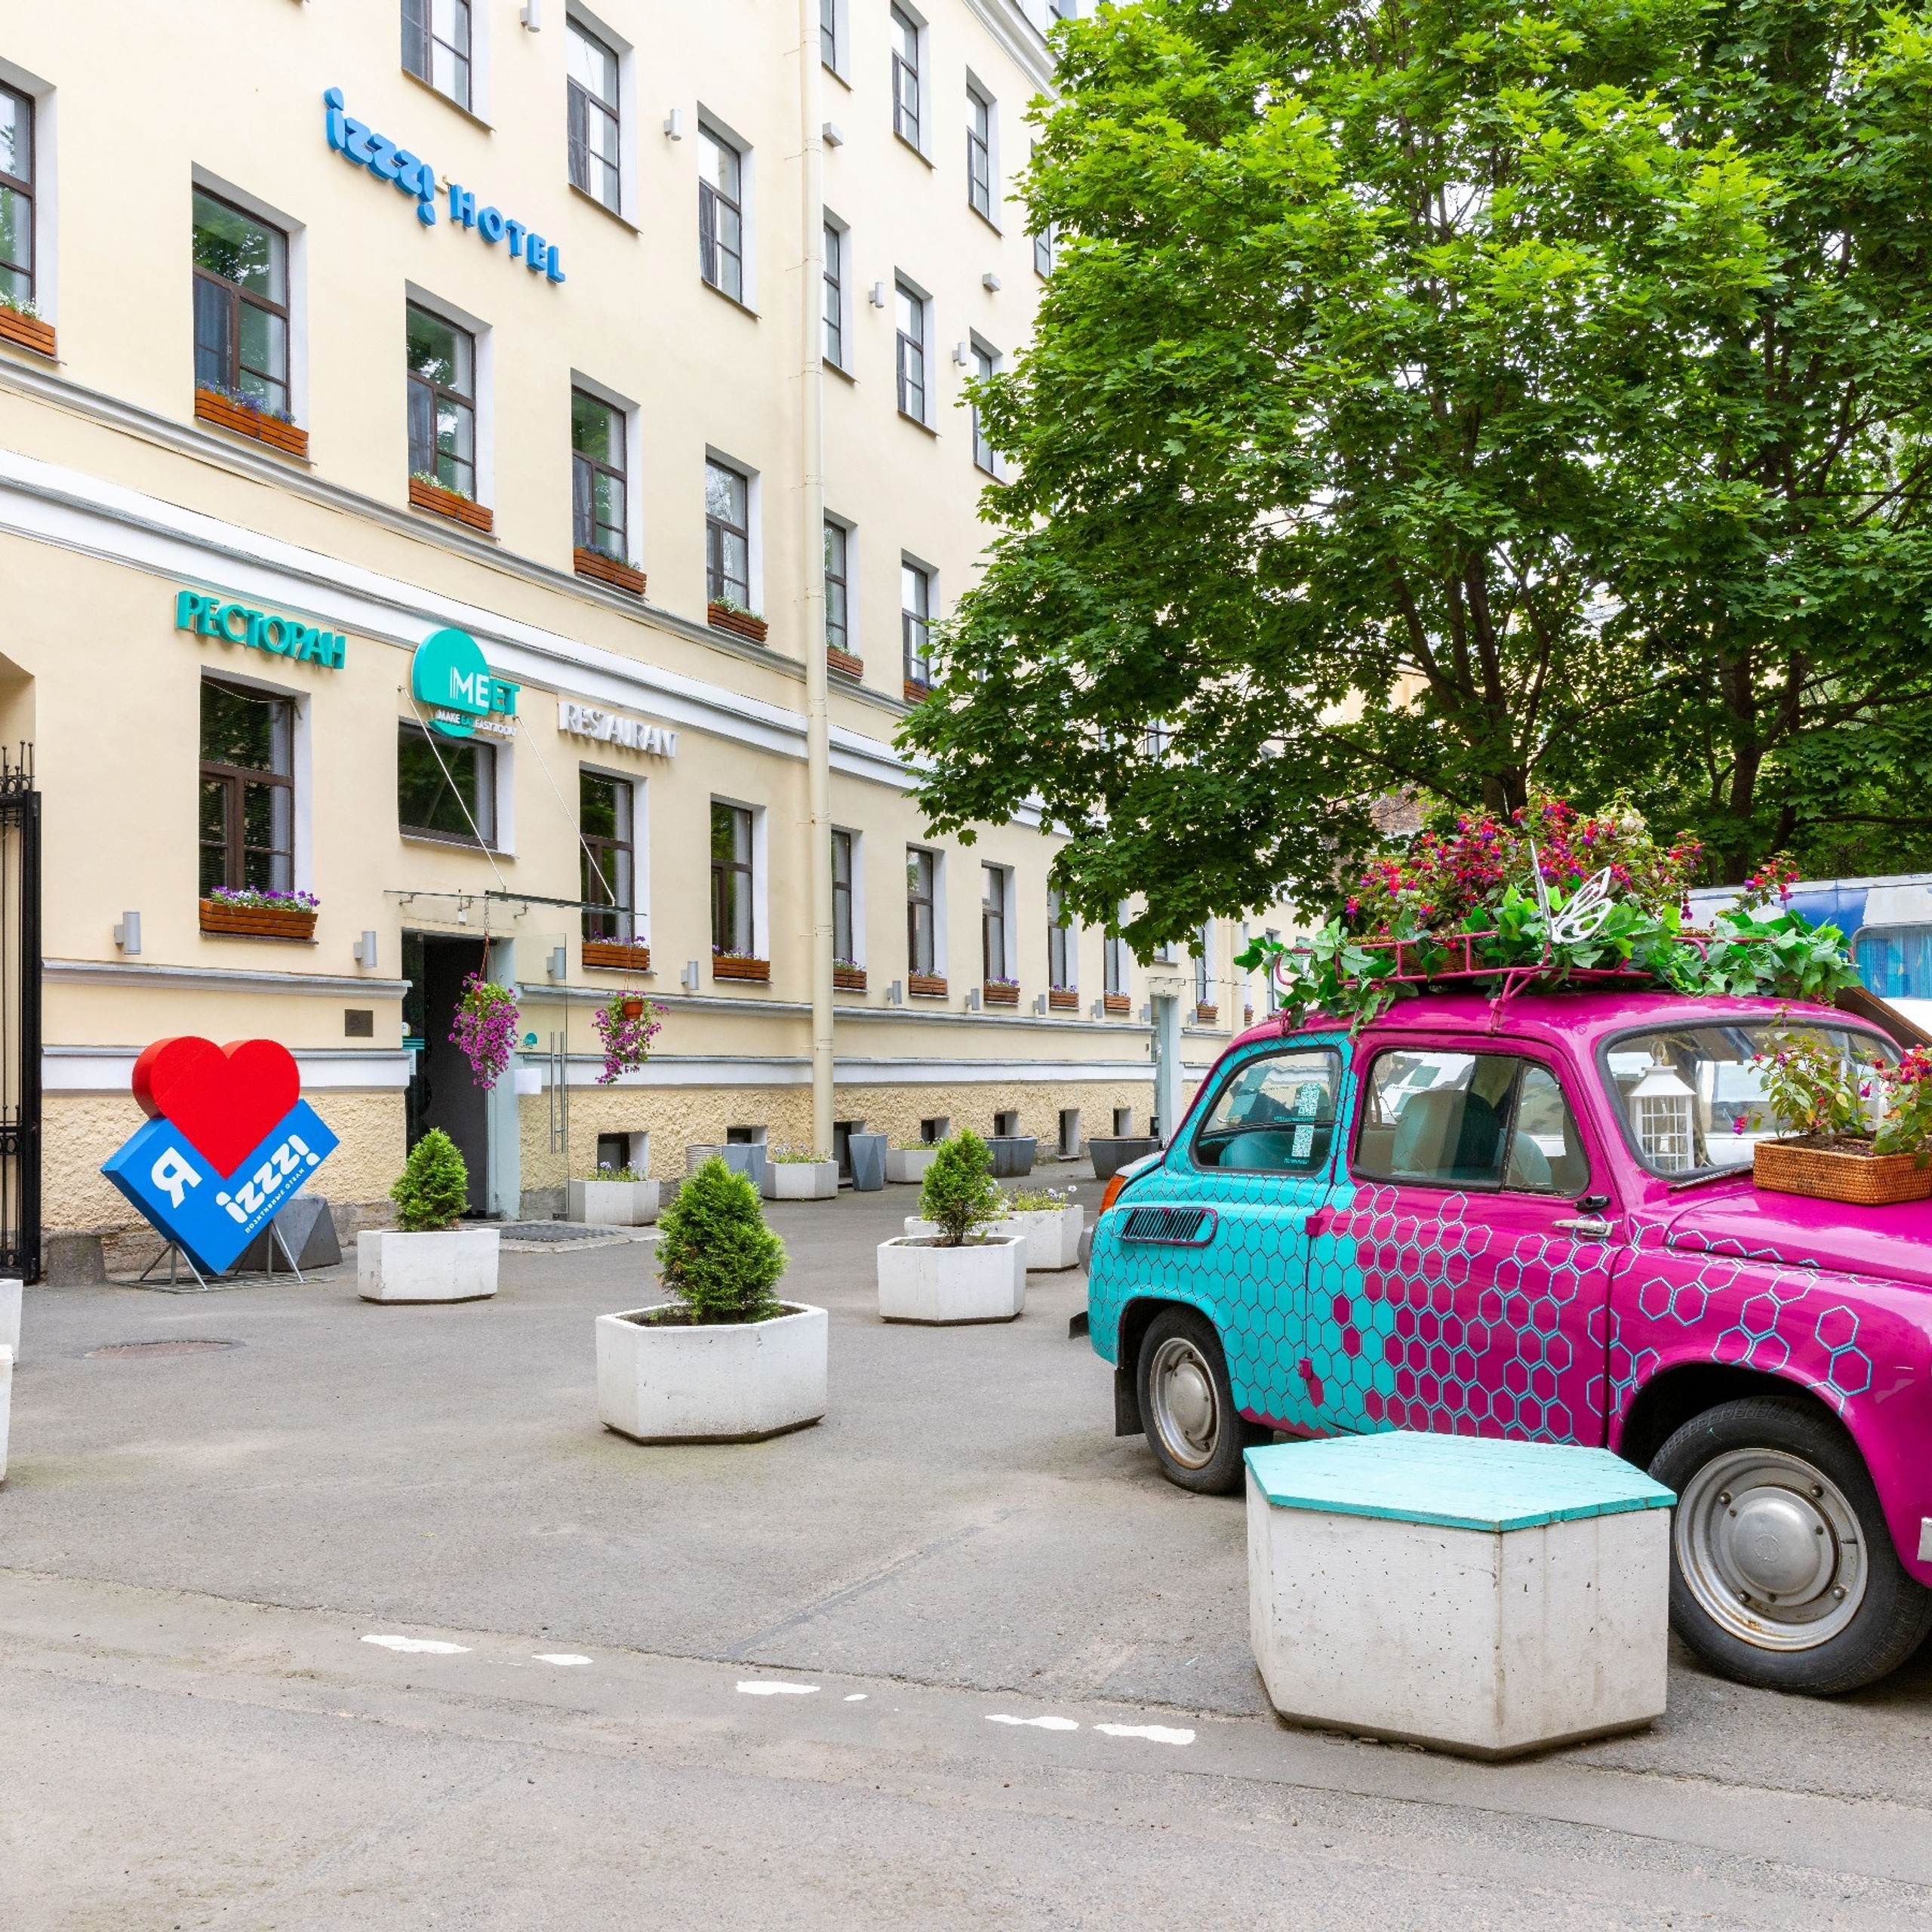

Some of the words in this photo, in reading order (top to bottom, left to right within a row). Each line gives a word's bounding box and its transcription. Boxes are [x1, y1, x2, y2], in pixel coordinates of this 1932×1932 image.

[448, 184, 565, 284] HOTEL
[176, 590, 346, 669] РЕСТОРАН
[435, 709, 460, 724] MAKE
[460, 715, 474, 727] EAT
[450, 666, 521, 715] MEET
[151, 1146, 203, 1209] Я
[245, 1189, 285, 1234] ПОЗИТИВНЫЕ
